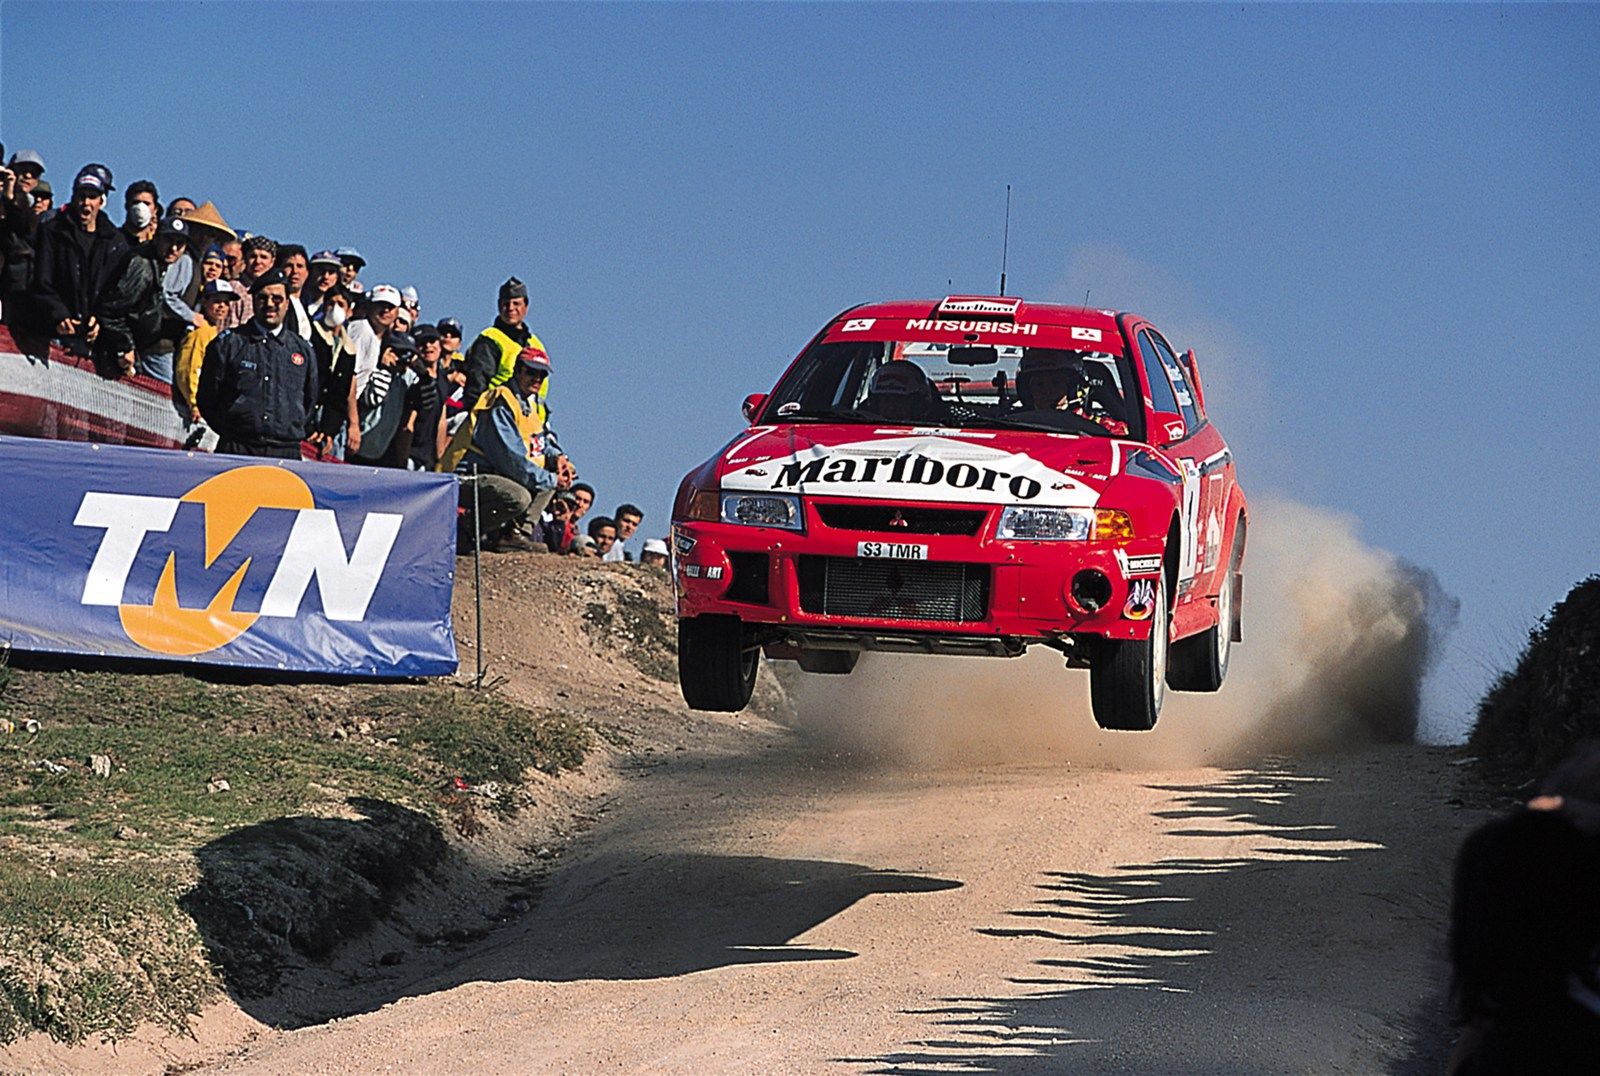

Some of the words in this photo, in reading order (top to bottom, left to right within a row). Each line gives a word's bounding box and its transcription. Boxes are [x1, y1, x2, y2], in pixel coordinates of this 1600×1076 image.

[943, 303, 1013, 312] Marlboro
[905, 319, 1038, 336] MITSUBISHI
[771, 453, 1041, 499] Marlboro
[73, 492, 404, 621] TMN
[863, 542, 882, 557] S3
[887, 543, 921, 559] TMR
